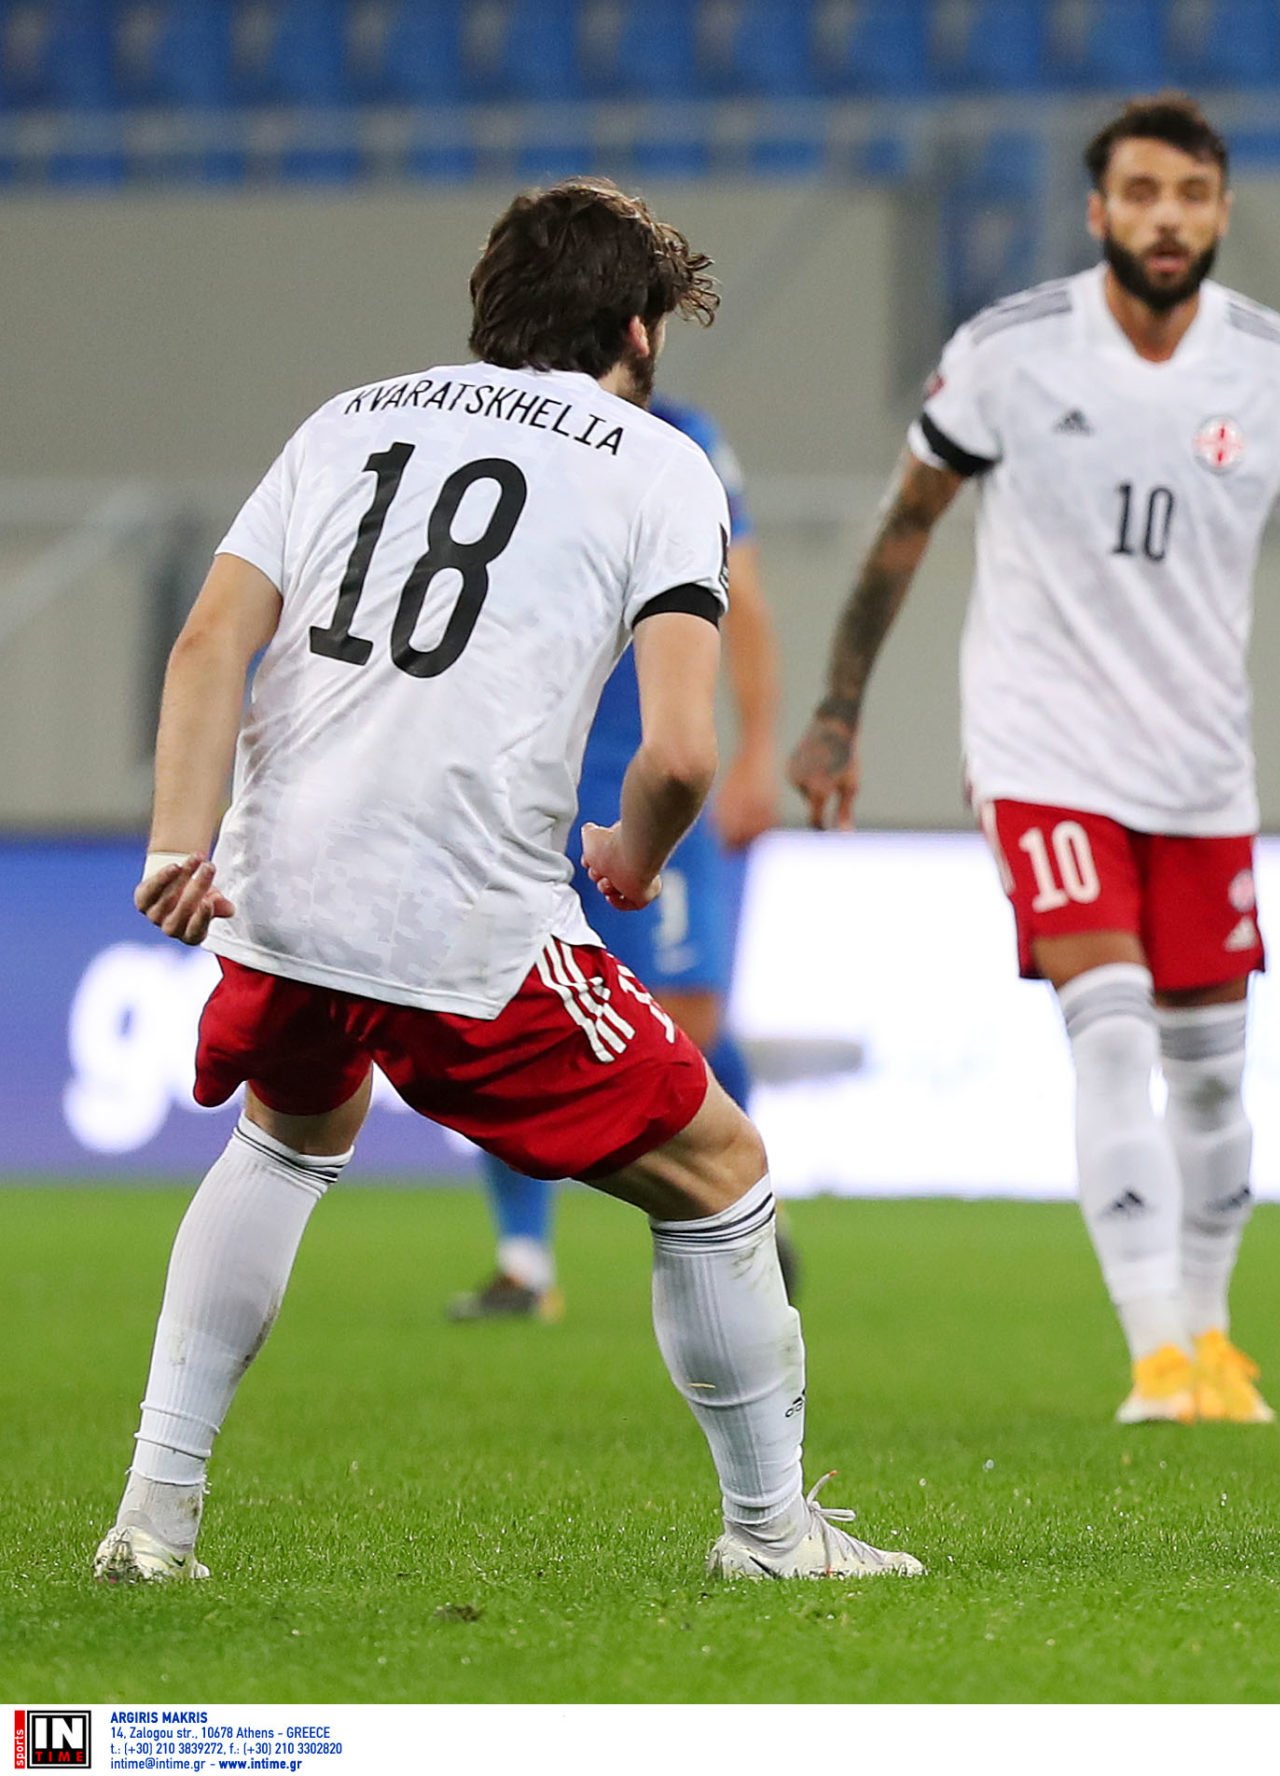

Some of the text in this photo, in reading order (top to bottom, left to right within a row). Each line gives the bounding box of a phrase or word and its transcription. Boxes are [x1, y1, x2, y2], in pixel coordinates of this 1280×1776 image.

[344, 379, 626, 456] KVARATSKHELIA
[308, 441, 528, 679] 18
[1112, 480, 1175, 563] 10
[1018, 820, 1100, 913] 10
